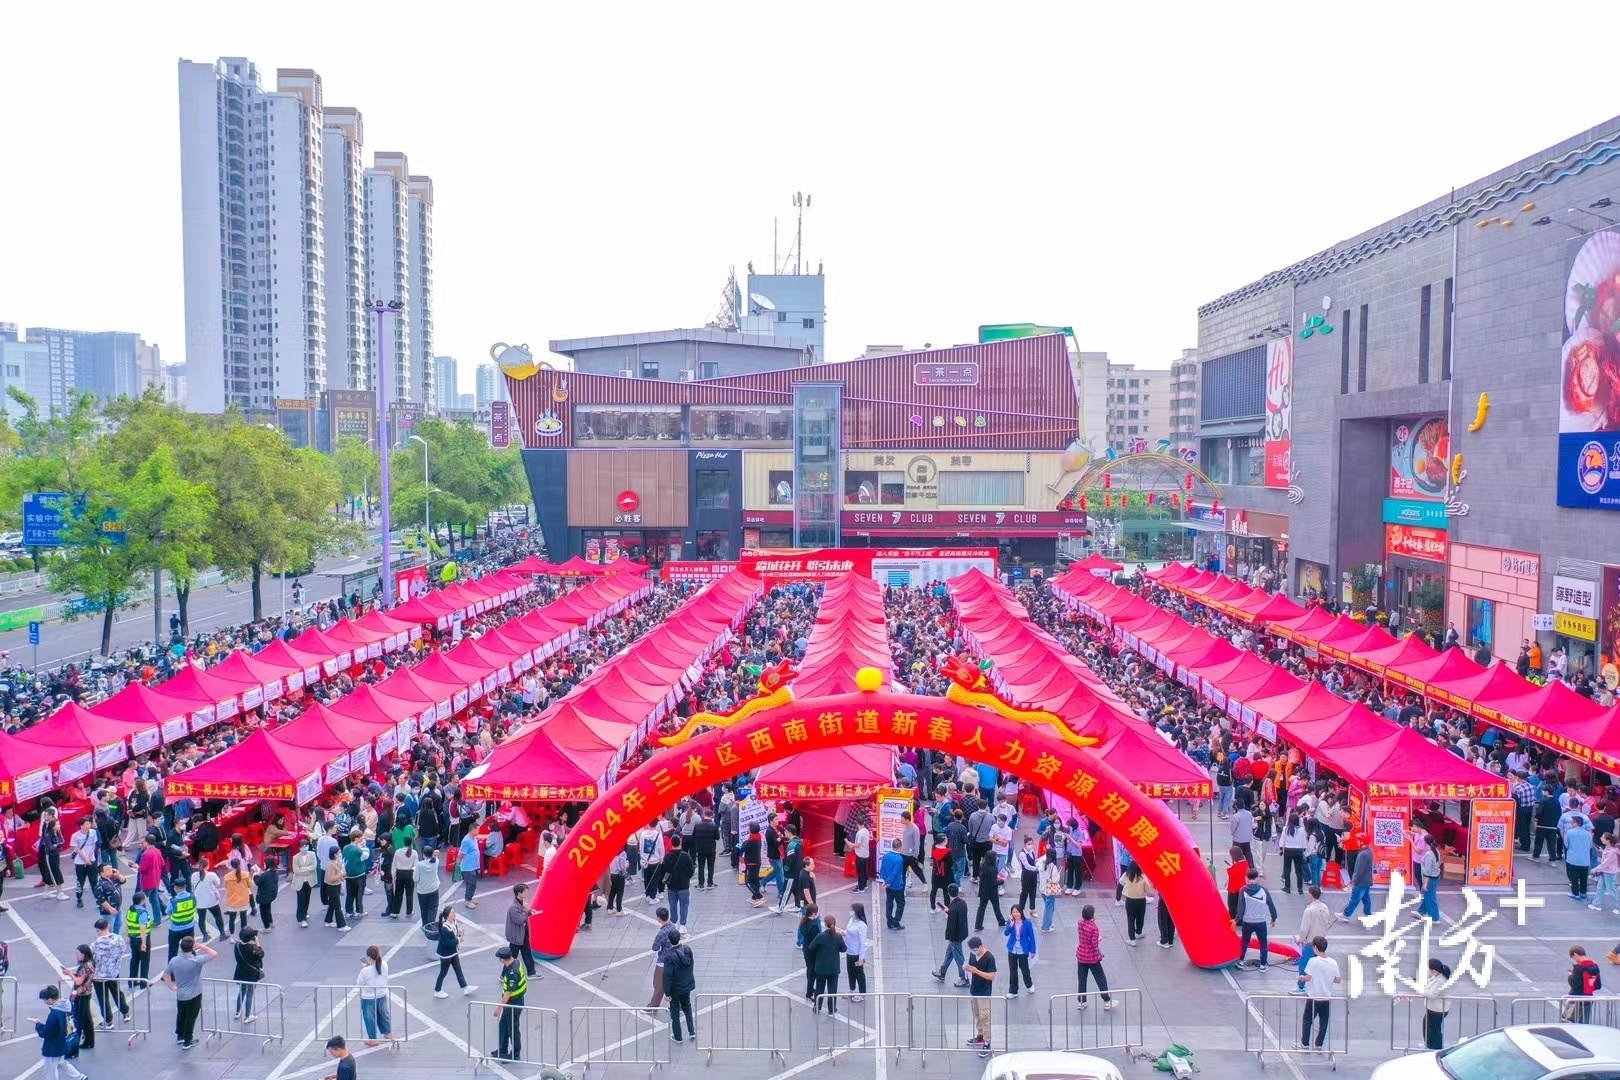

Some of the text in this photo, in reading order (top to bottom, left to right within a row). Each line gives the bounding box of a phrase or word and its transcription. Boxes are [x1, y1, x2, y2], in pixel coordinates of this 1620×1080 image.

[921, 367, 972, 377] 一茶一点
[493, 405, 503, 443] 一茶一点
[695, 451, 715, 460] Pizza
[873, 455, 896, 466] 美发
[614, 514, 641, 523] 必胜客
[854, 513, 883, 523] SEVEN
[910, 513, 933, 523] CLUB
[957, 513, 987, 523] SEVEN
[1014, 514, 1037, 523] CLUB
[1556, 586, 1592, 607] 藤野造型
[568, 709, 1183, 879] 2024年三水区西南街道新春人力资源招聘会
